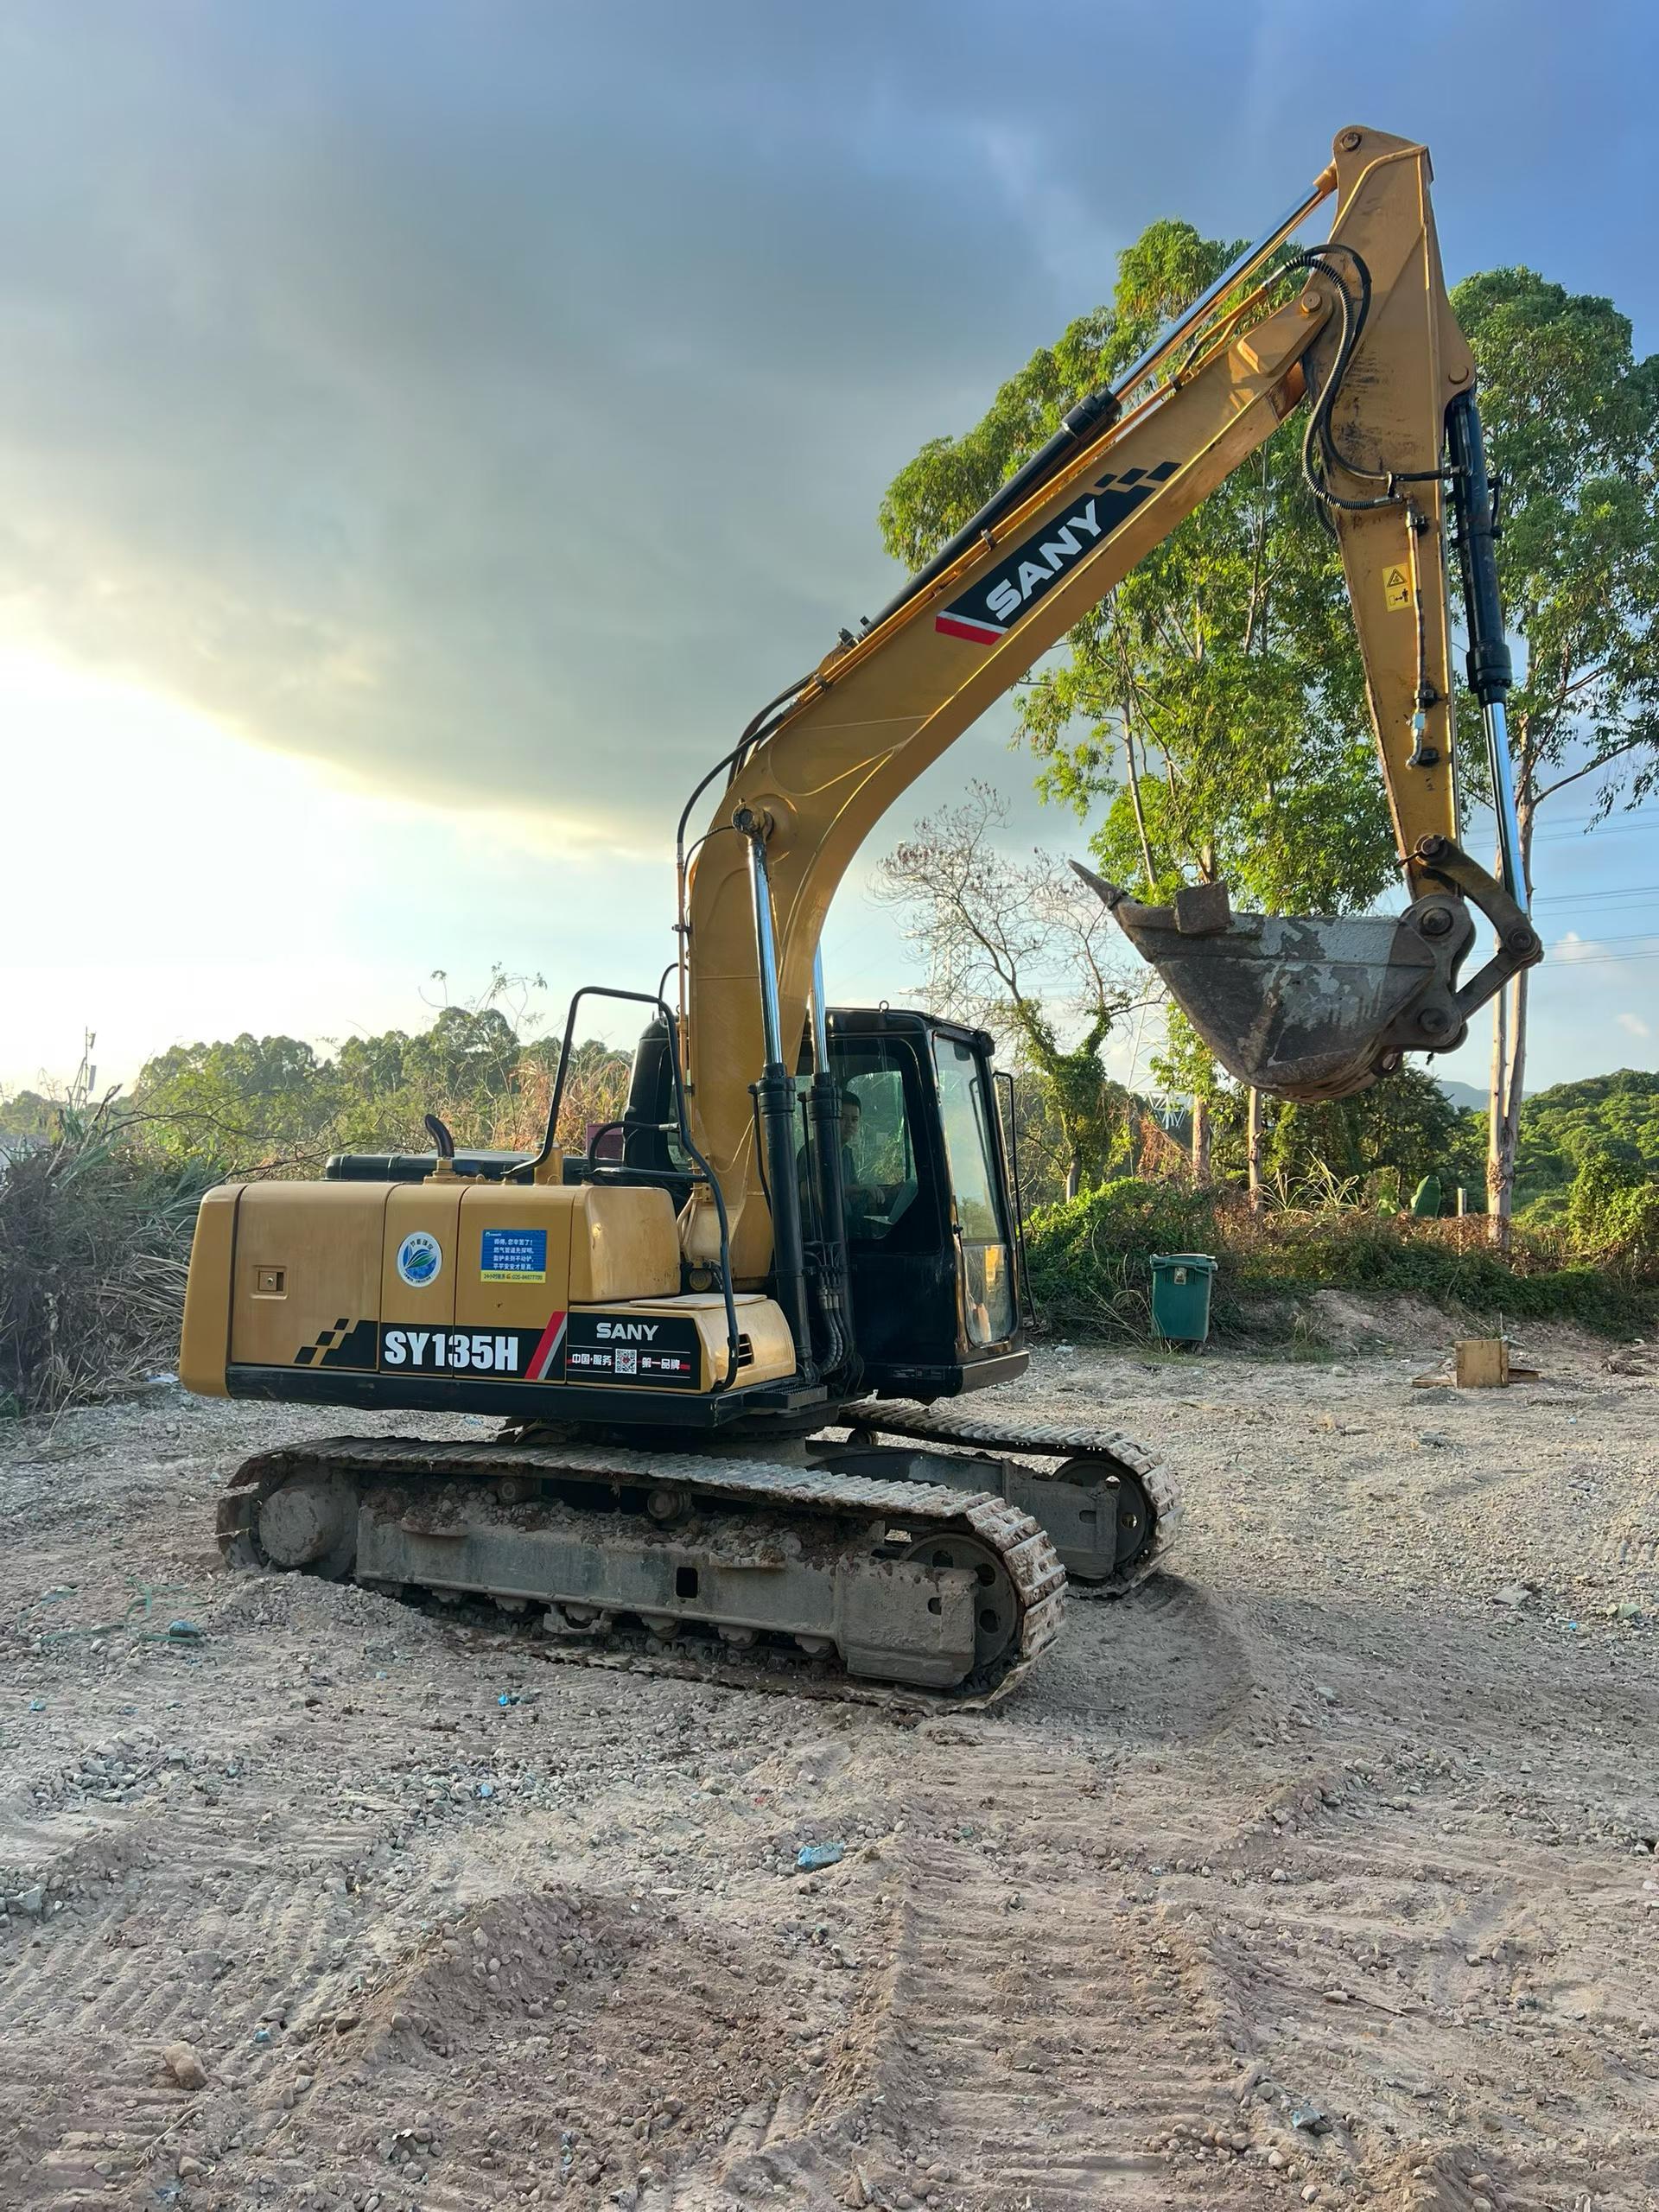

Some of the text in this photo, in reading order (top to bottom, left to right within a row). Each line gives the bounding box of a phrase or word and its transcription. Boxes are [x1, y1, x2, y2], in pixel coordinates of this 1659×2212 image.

[986, 499, 1102, 621] SANY
[596, 1322, 659, 1341] SANY
[384, 1331, 518, 1371] SY135H
[641, 1357, 681, 1370] 第一品牌
